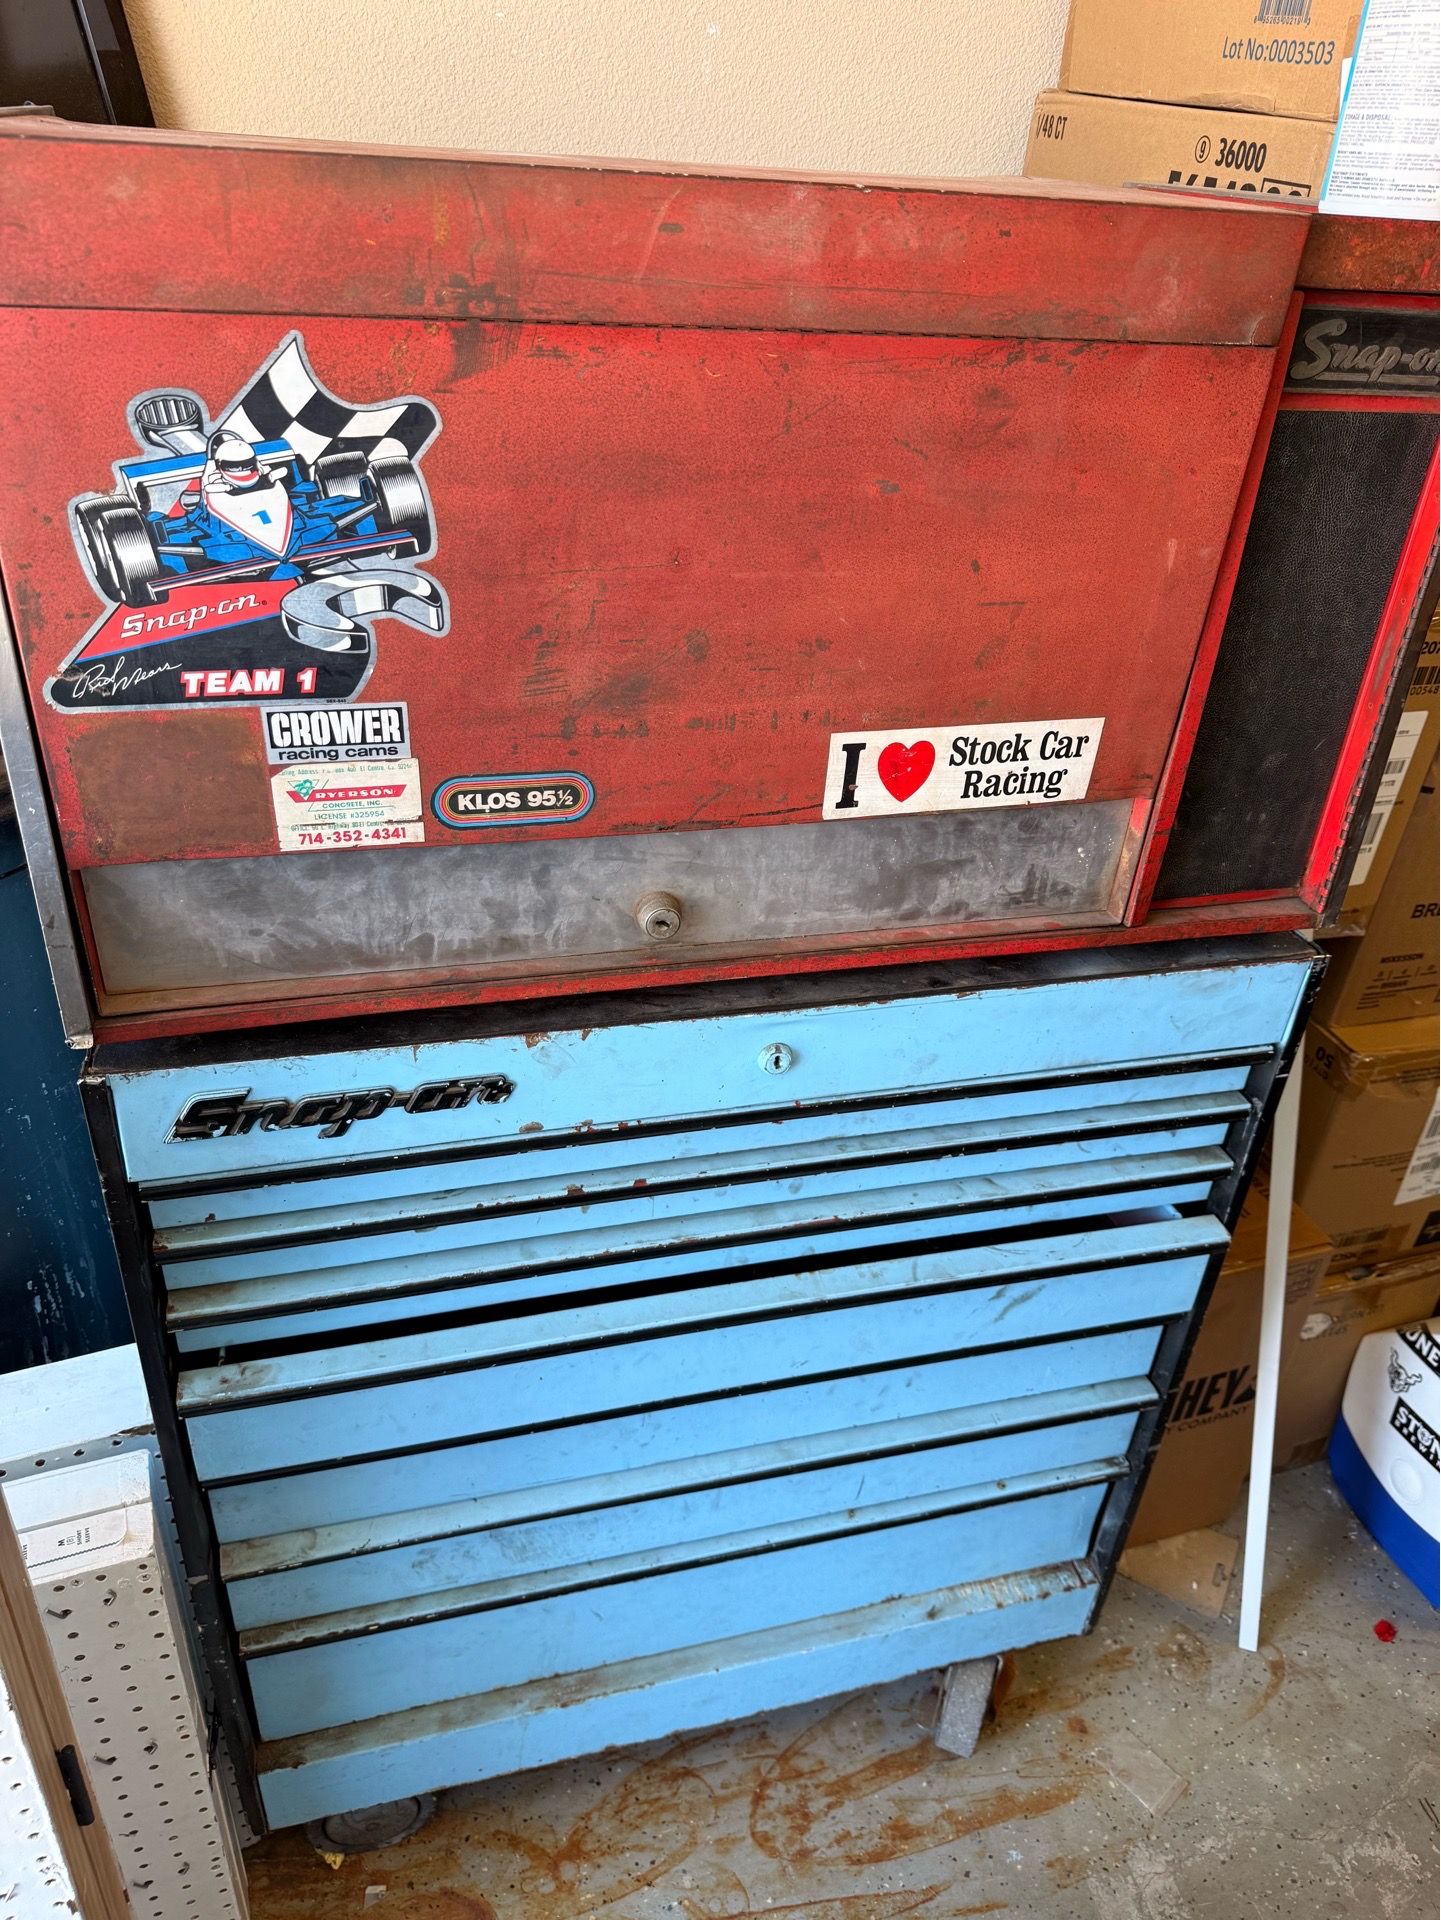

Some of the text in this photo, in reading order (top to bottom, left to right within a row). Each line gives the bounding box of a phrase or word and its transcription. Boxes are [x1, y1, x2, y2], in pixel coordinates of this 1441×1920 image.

[1222, 36, 1243, 59] Lot
[1055, 115, 1068, 140] CT
[1215, 137, 1268, 173] 36000
[252, 510, 272, 525] 1
[120, 593, 259, 638] Snap-on
[182, 668, 317, 696] TEAM 1
[271, 709, 401, 747] CROWER
[279, 746, 398, 760] racing cams
[835, 731, 1090, 809] I Stock Car
[960, 767, 1068, 799] Racing
[315, 789, 393, 798] RYERSON
[457, 791, 521, 812] KLOS
[163, 1072, 515, 1144] Snap-on
